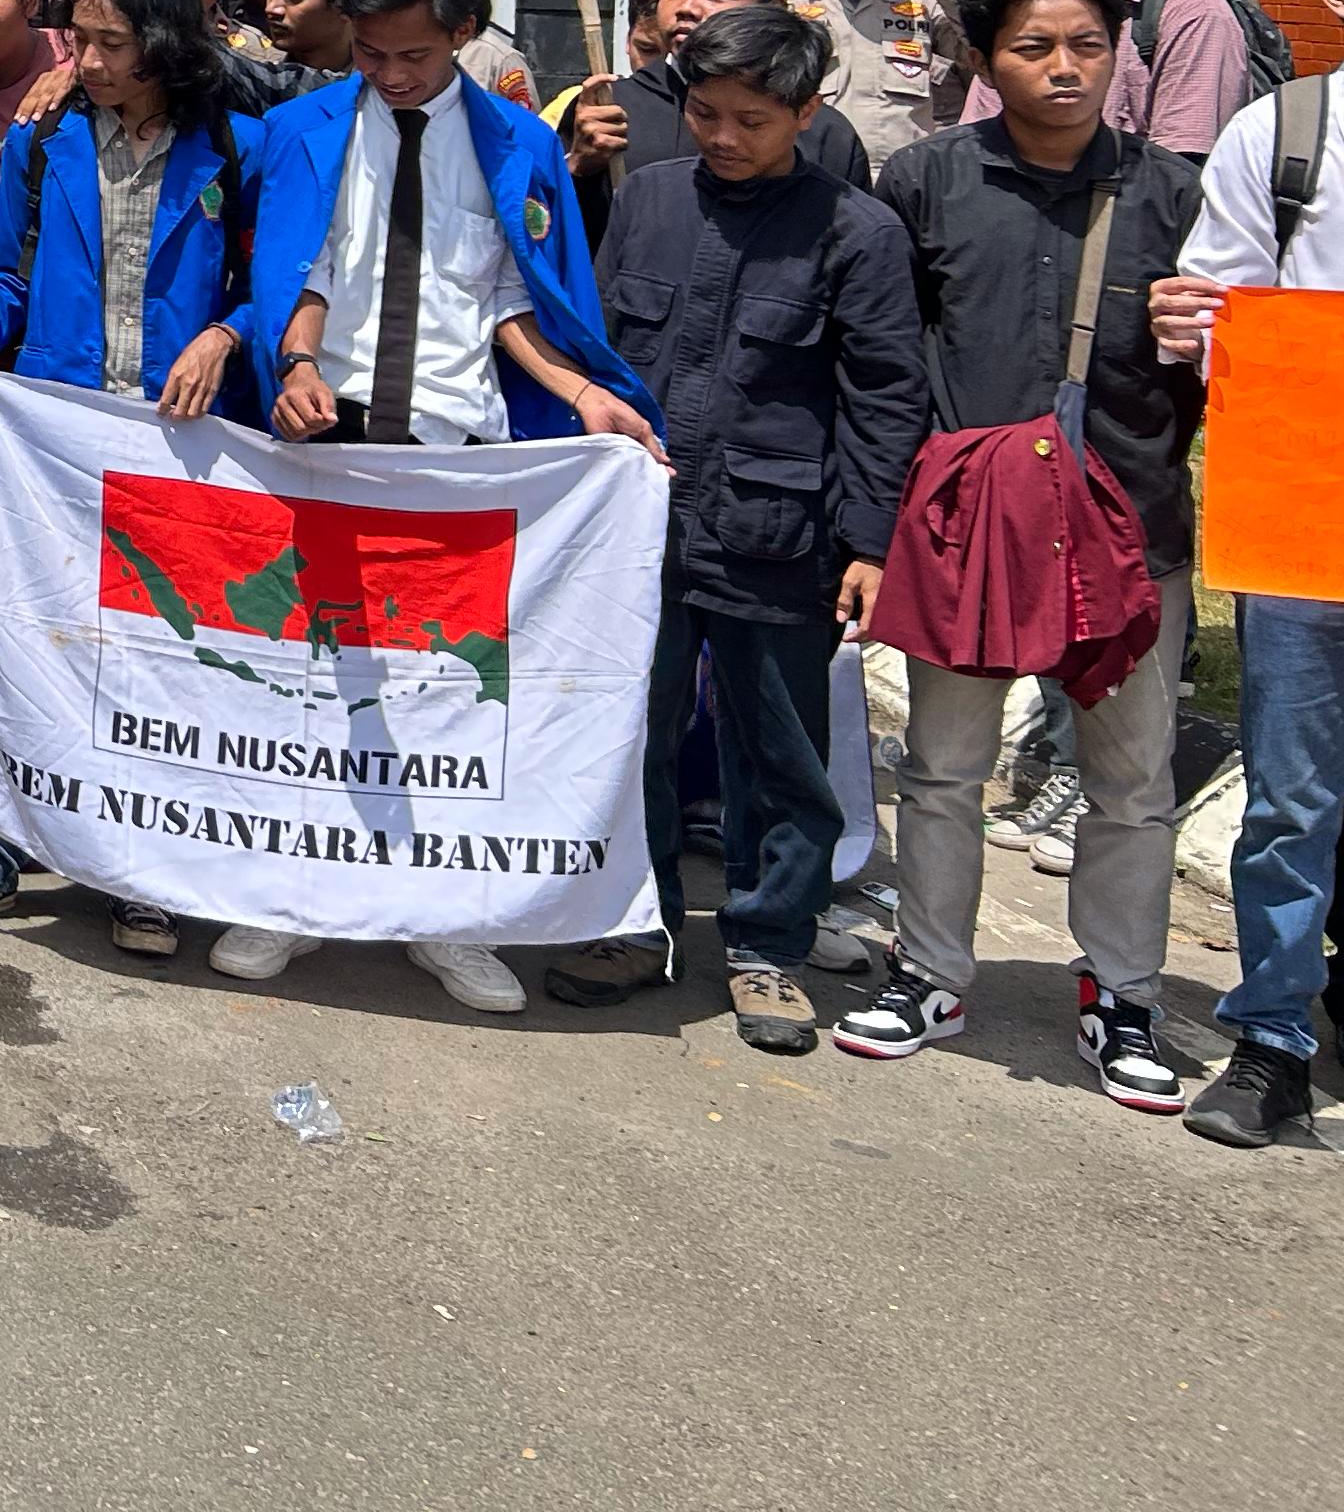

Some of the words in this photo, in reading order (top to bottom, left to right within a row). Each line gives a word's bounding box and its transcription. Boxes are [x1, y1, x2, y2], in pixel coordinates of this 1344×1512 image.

[112, 710, 200, 760] BEM
[217, 731, 489, 790] NUSANTARA
[96, 784, 393, 867] NUSANTARA
[409, 833, 611, 876] BANTEN
